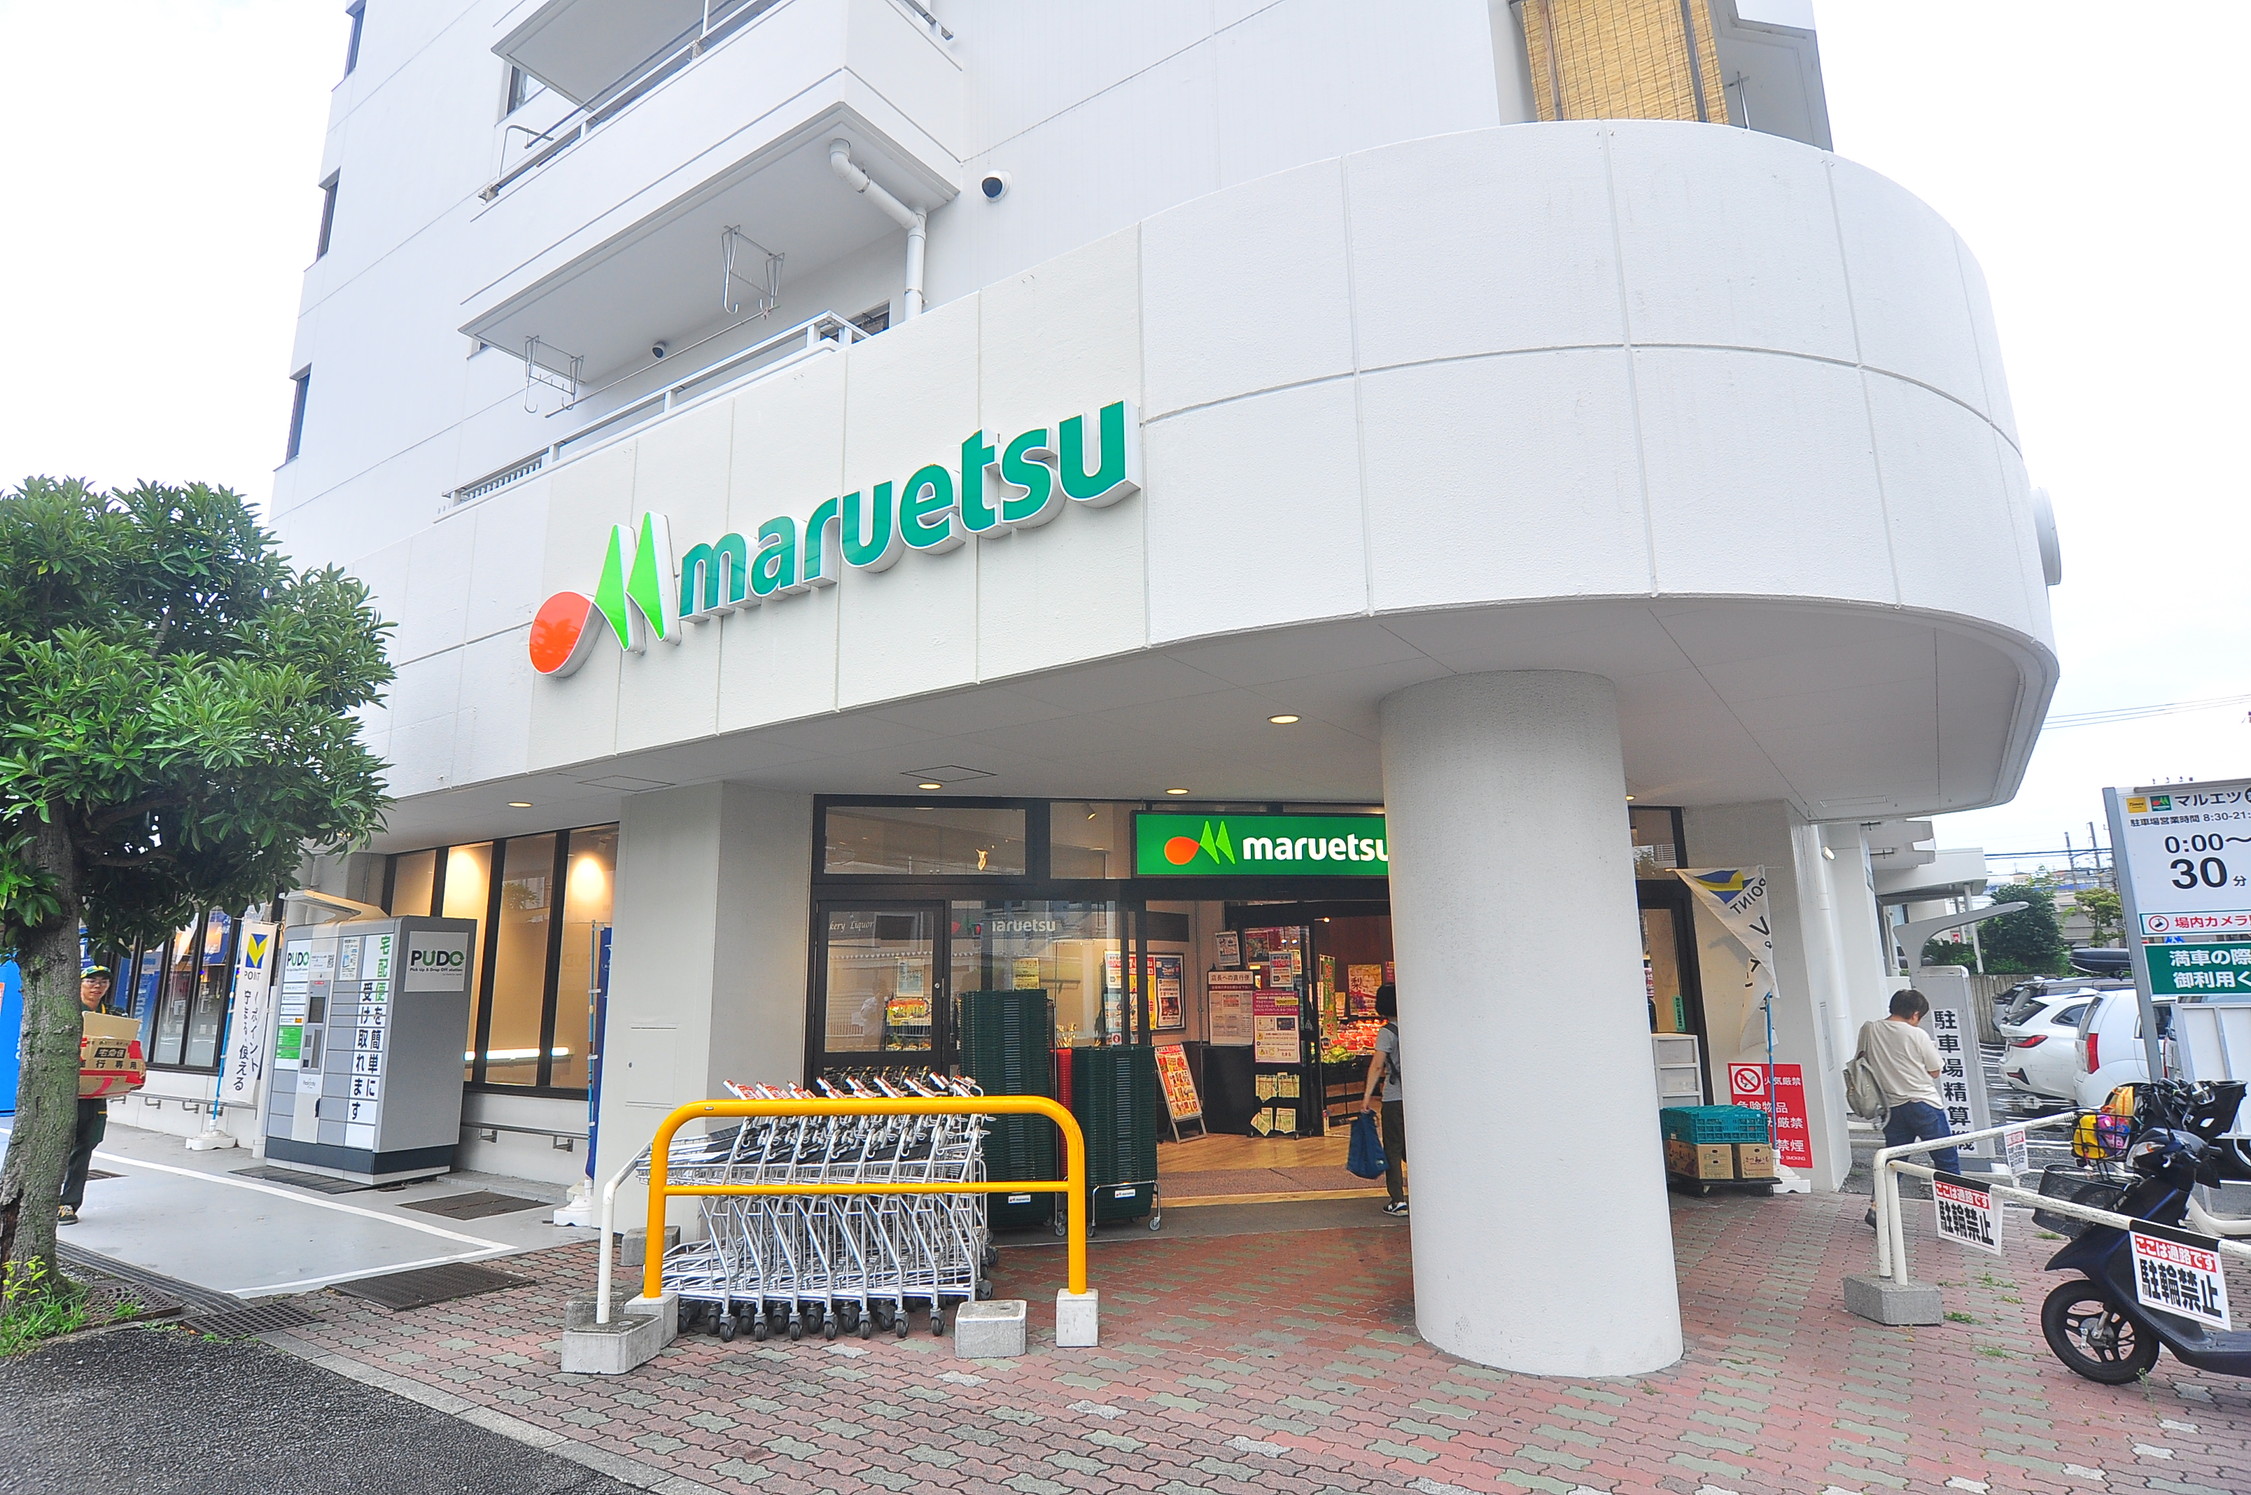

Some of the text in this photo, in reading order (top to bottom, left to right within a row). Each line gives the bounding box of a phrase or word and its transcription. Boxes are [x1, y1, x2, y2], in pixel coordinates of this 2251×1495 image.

[678, 399, 1132, 622] maruetsu
[2175, 791, 2242, 806] マルエツ
[2130, 815, 2200, 827] 駐車場営業時間
[1243, 833, 1389, 862] maruetsu
[2170, 857, 2247, 889] 30 分
[850, 919, 875, 931] Liquor
[992, 918, 1056, 932] aruetsu
[2174, 915, 2251, 928] 場内カメラ
[287, 951, 310, 966] PUDO
[410, 949, 465, 967] PUDO
[2169, 948, 2251, 967] 満車の際
[2172, 971, 2251, 989] 御利用く
[365, 935, 391, 1097] 宅配便を簡単に
[351, 982, 374, 1120] 受け取れます
[1935, 1182, 1989, 1208] ここは通路です
[1938, 1200, 1995, 1246] 駐輪禁止
[2135, 1237, 2215, 1271] ここは通路です
[2139, 1258, 2223, 1319] 駐輪禁止
